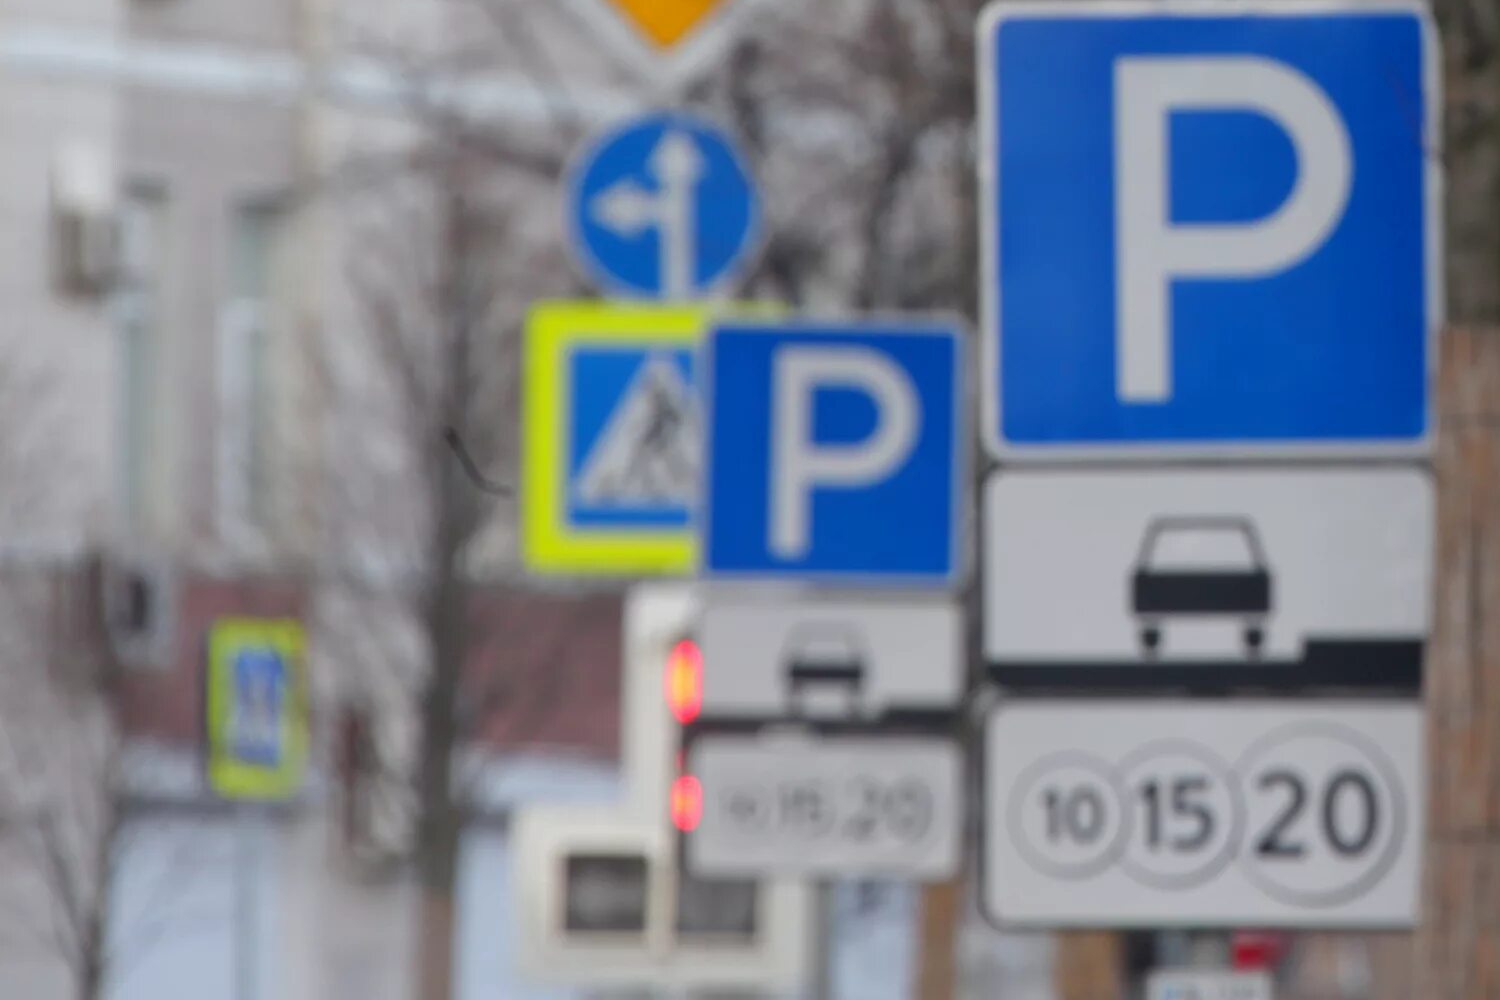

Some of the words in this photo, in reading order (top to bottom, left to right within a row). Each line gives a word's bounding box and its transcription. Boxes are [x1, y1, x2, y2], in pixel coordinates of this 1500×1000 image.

[1113, 54, 1354, 403] P
[768, 341, 924, 560] P
[1039, 788, 1104, 844] 10
[1139, 775, 1215, 850] 15
[1256, 768, 1379, 856] 20
